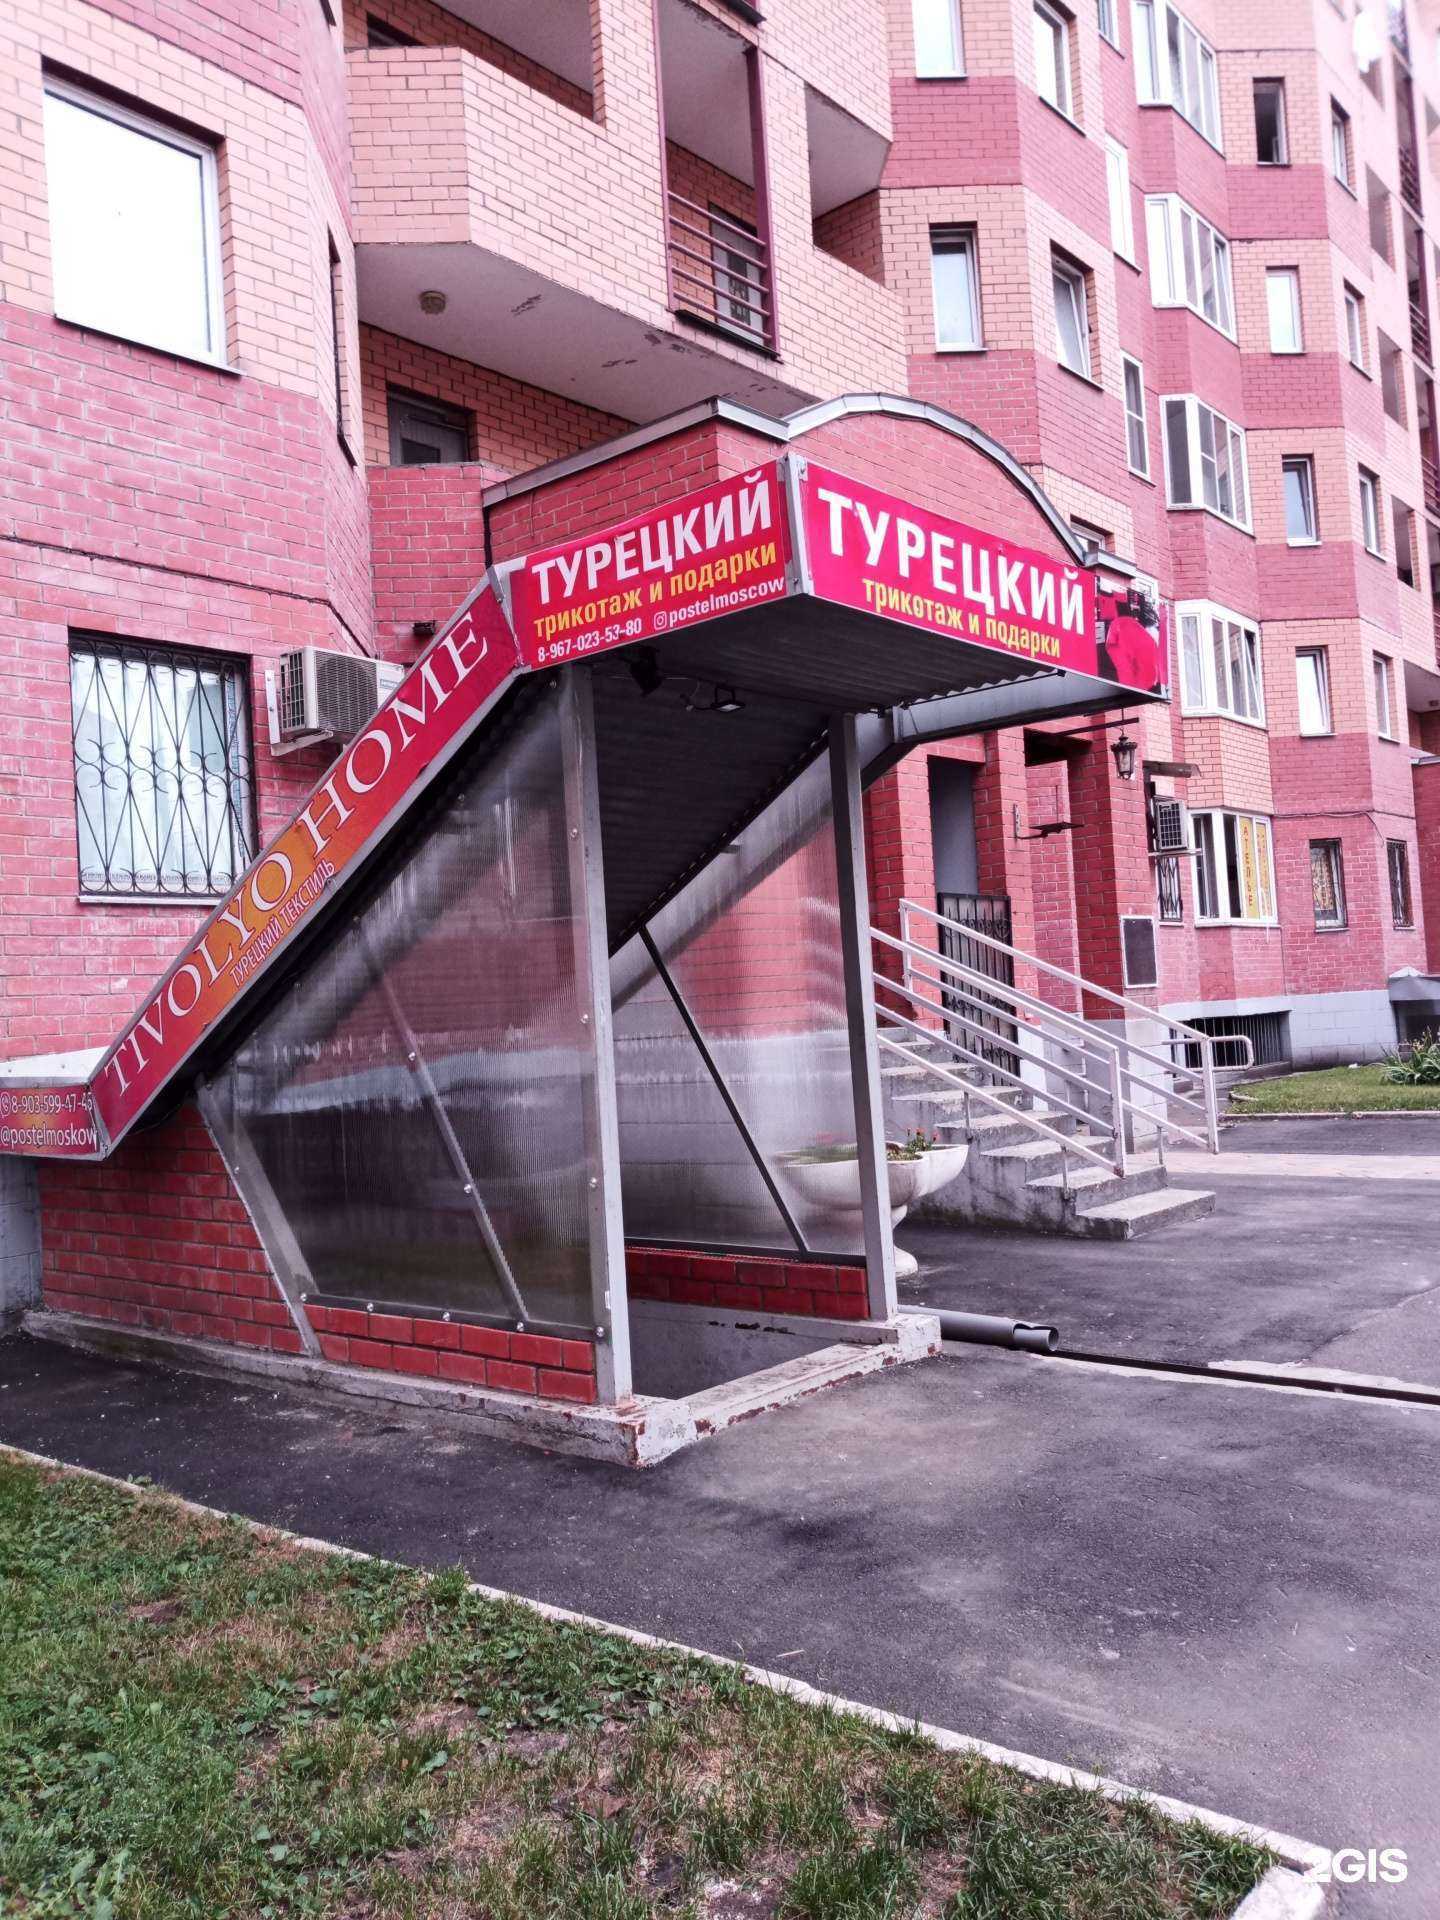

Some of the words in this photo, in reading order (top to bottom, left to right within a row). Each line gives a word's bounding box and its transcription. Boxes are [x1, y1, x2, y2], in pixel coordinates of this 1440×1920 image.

[531, 470, 771, 605] ТУРЕЦКИЙ
[533, 587, 643, 642] трикотаж
[649, 575, 663, 604] и
[669, 541, 777, 592] подарки
[817, 488, 1085, 635] ТУРЕЦКИЙ
[536, 618, 643, 663] 8-967-023-53-80
[669, 576, 785, 627] postelmoscow
[862, 578, 963, 631] трикотаж
[968, 615, 980, 637] и
[985, 618, 1061, 660] подарки
[104, 851, 293, 1097] TIVOLYO
[297, 611, 489, 858] HOME
[229, 915, 284, 987] ТУРЕЦКИЙ
[279, 860, 335, 928] ТЕКСТИЛЬ
